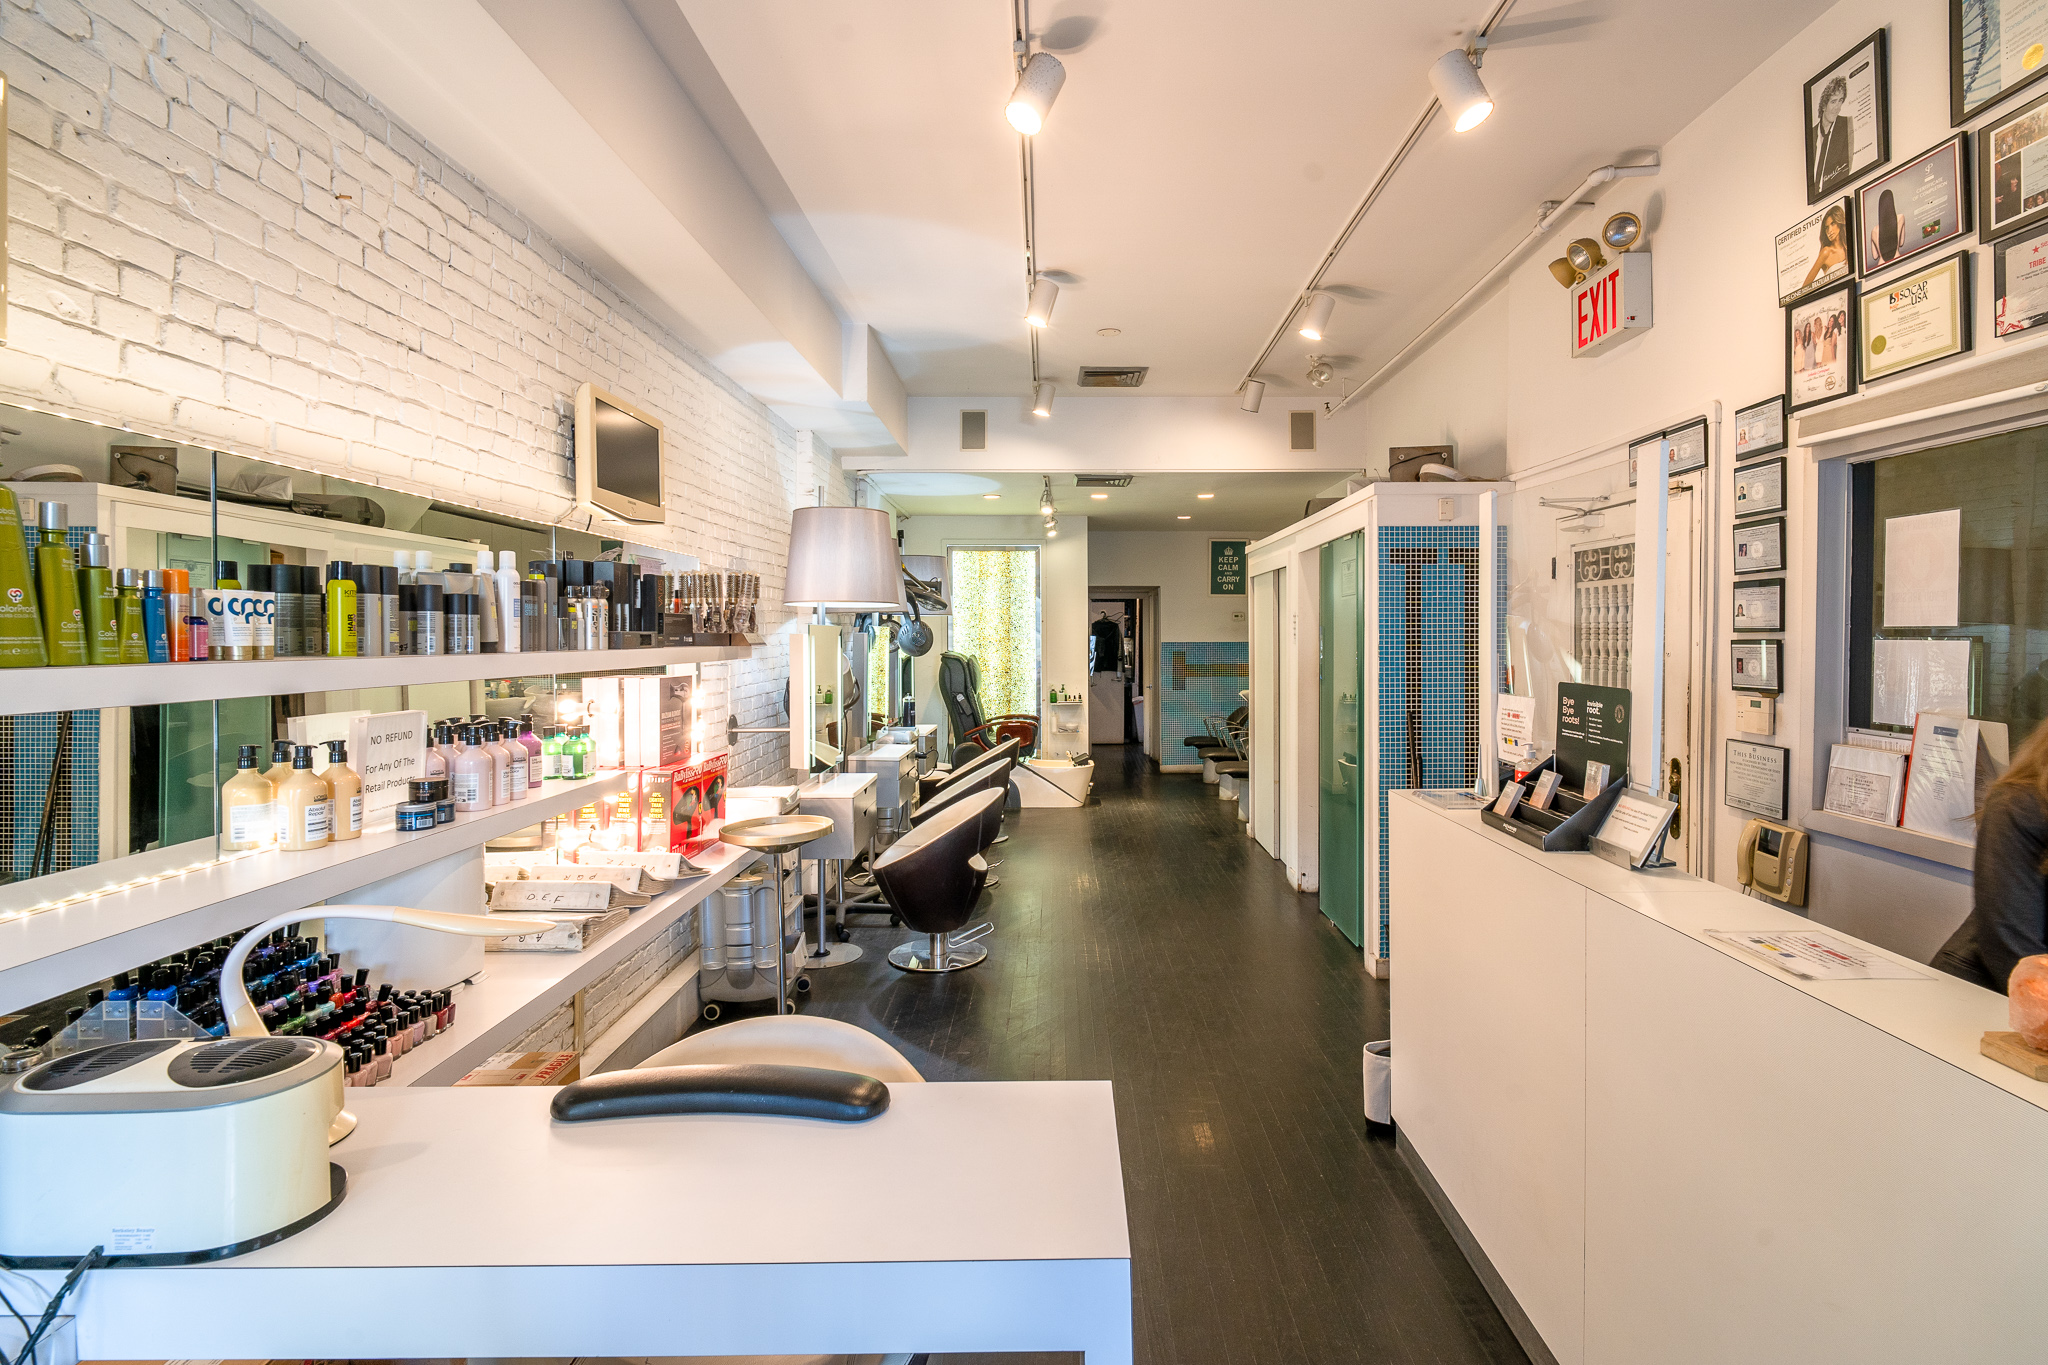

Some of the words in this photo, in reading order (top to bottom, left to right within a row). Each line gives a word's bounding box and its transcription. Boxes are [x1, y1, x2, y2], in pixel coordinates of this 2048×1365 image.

[1777, 227, 1802, 246] CERTIFIED
[1803, 214, 1823, 232] STYLIST
[2028, 256, 2047, 269] TRIBE
[1911, 291, 1928, 306] USA
[1577, 268, 1620, 349] EXIT
[1562, 696, 1575, 707] Bye
[1562, 705, 1575, 716] Bye
[1586, 707, 1601, 715] root.
[1561, 715, 1580, 725] roots!
[370, 735, 382, 746] NO
[385, 730, 413, 743] REFUND
[1733, 749, 1747, 758] THIS
[1748, 752, 1777, 764] BUSINESS
[365, 765, 377, 775] For
[378, 762, 392, 771] Any
[393, 759, 402, 768] Of
[403, 756, 416, 766] The
[365, 780, 386, 794] Retail
[535, 1053, 574, 1080] FRAGILE
